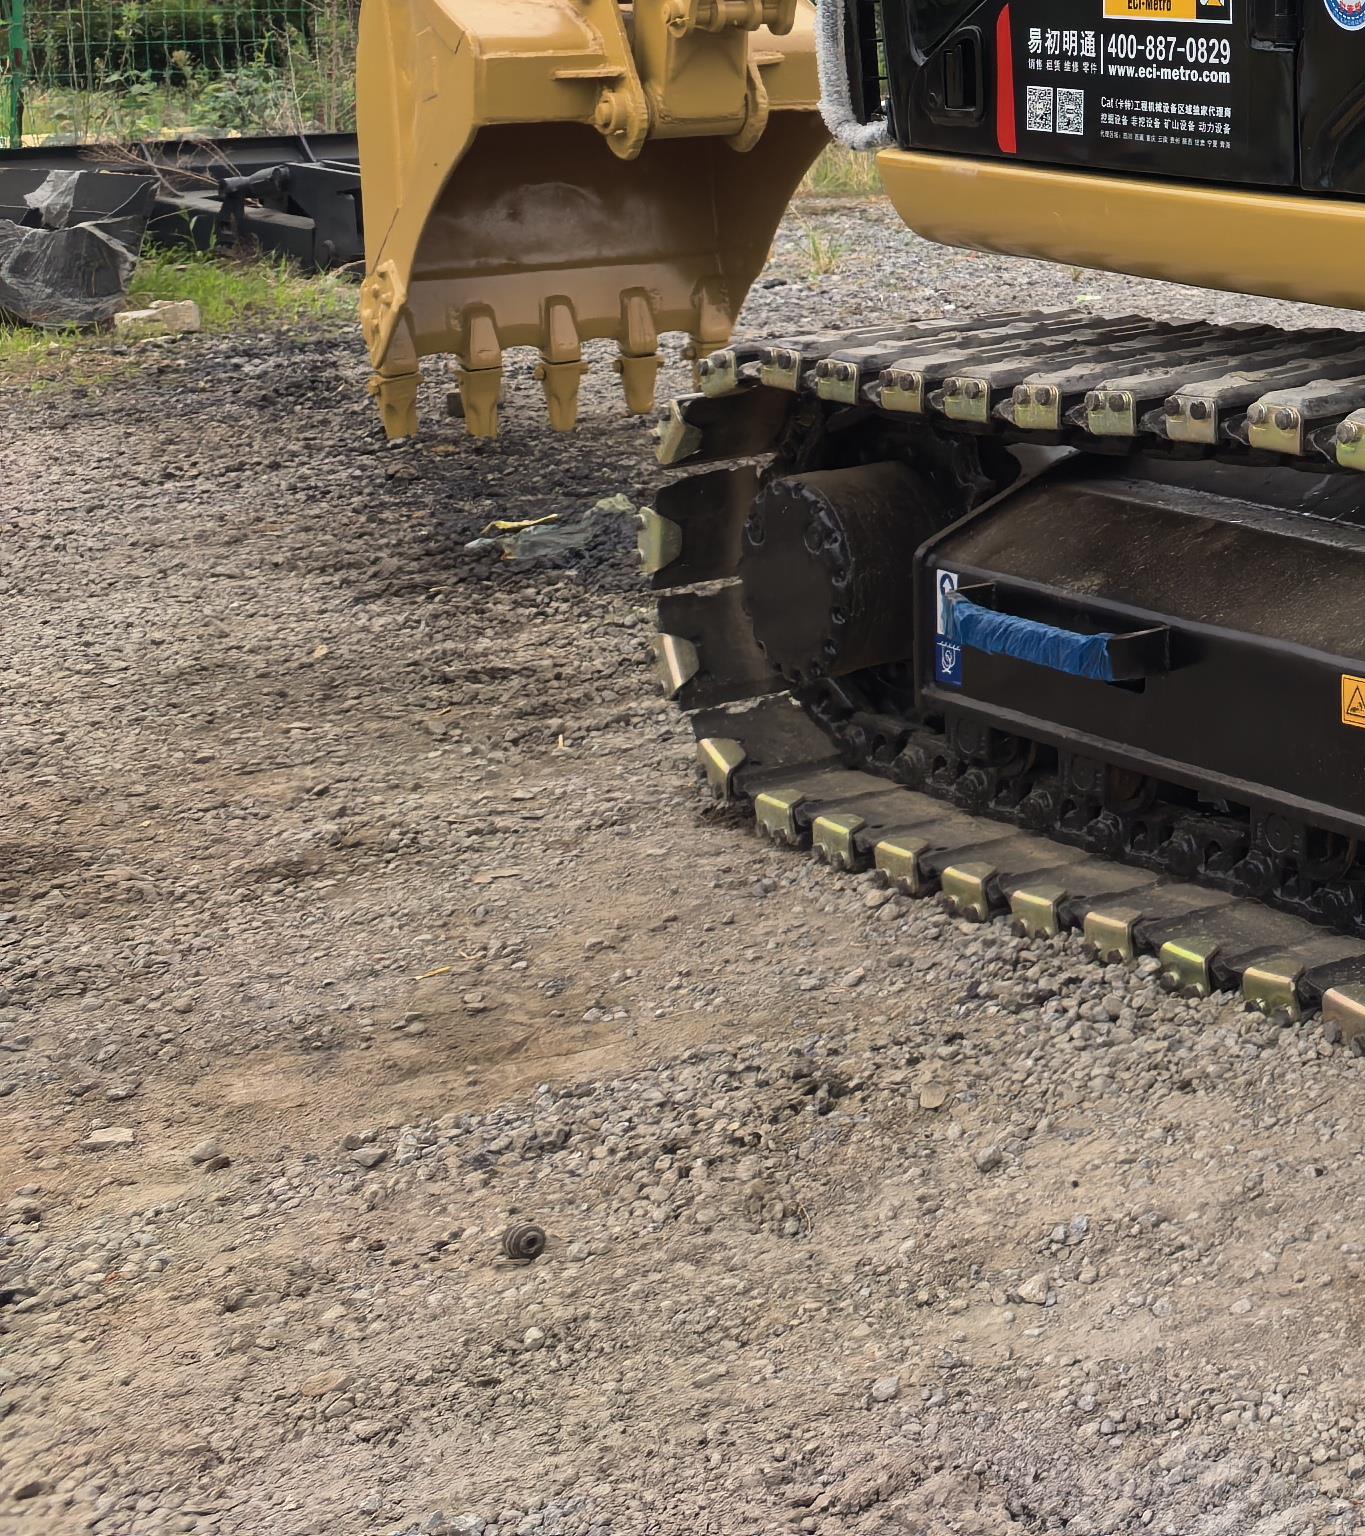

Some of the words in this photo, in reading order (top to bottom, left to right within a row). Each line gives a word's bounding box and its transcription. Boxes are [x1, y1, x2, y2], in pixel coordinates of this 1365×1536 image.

[1027, 27, 1097, 58] 易初明通
[1107, 33, 1231, 65] 400-887-0829
[1108, 64, 1231, 83] www.eci-metro.com
